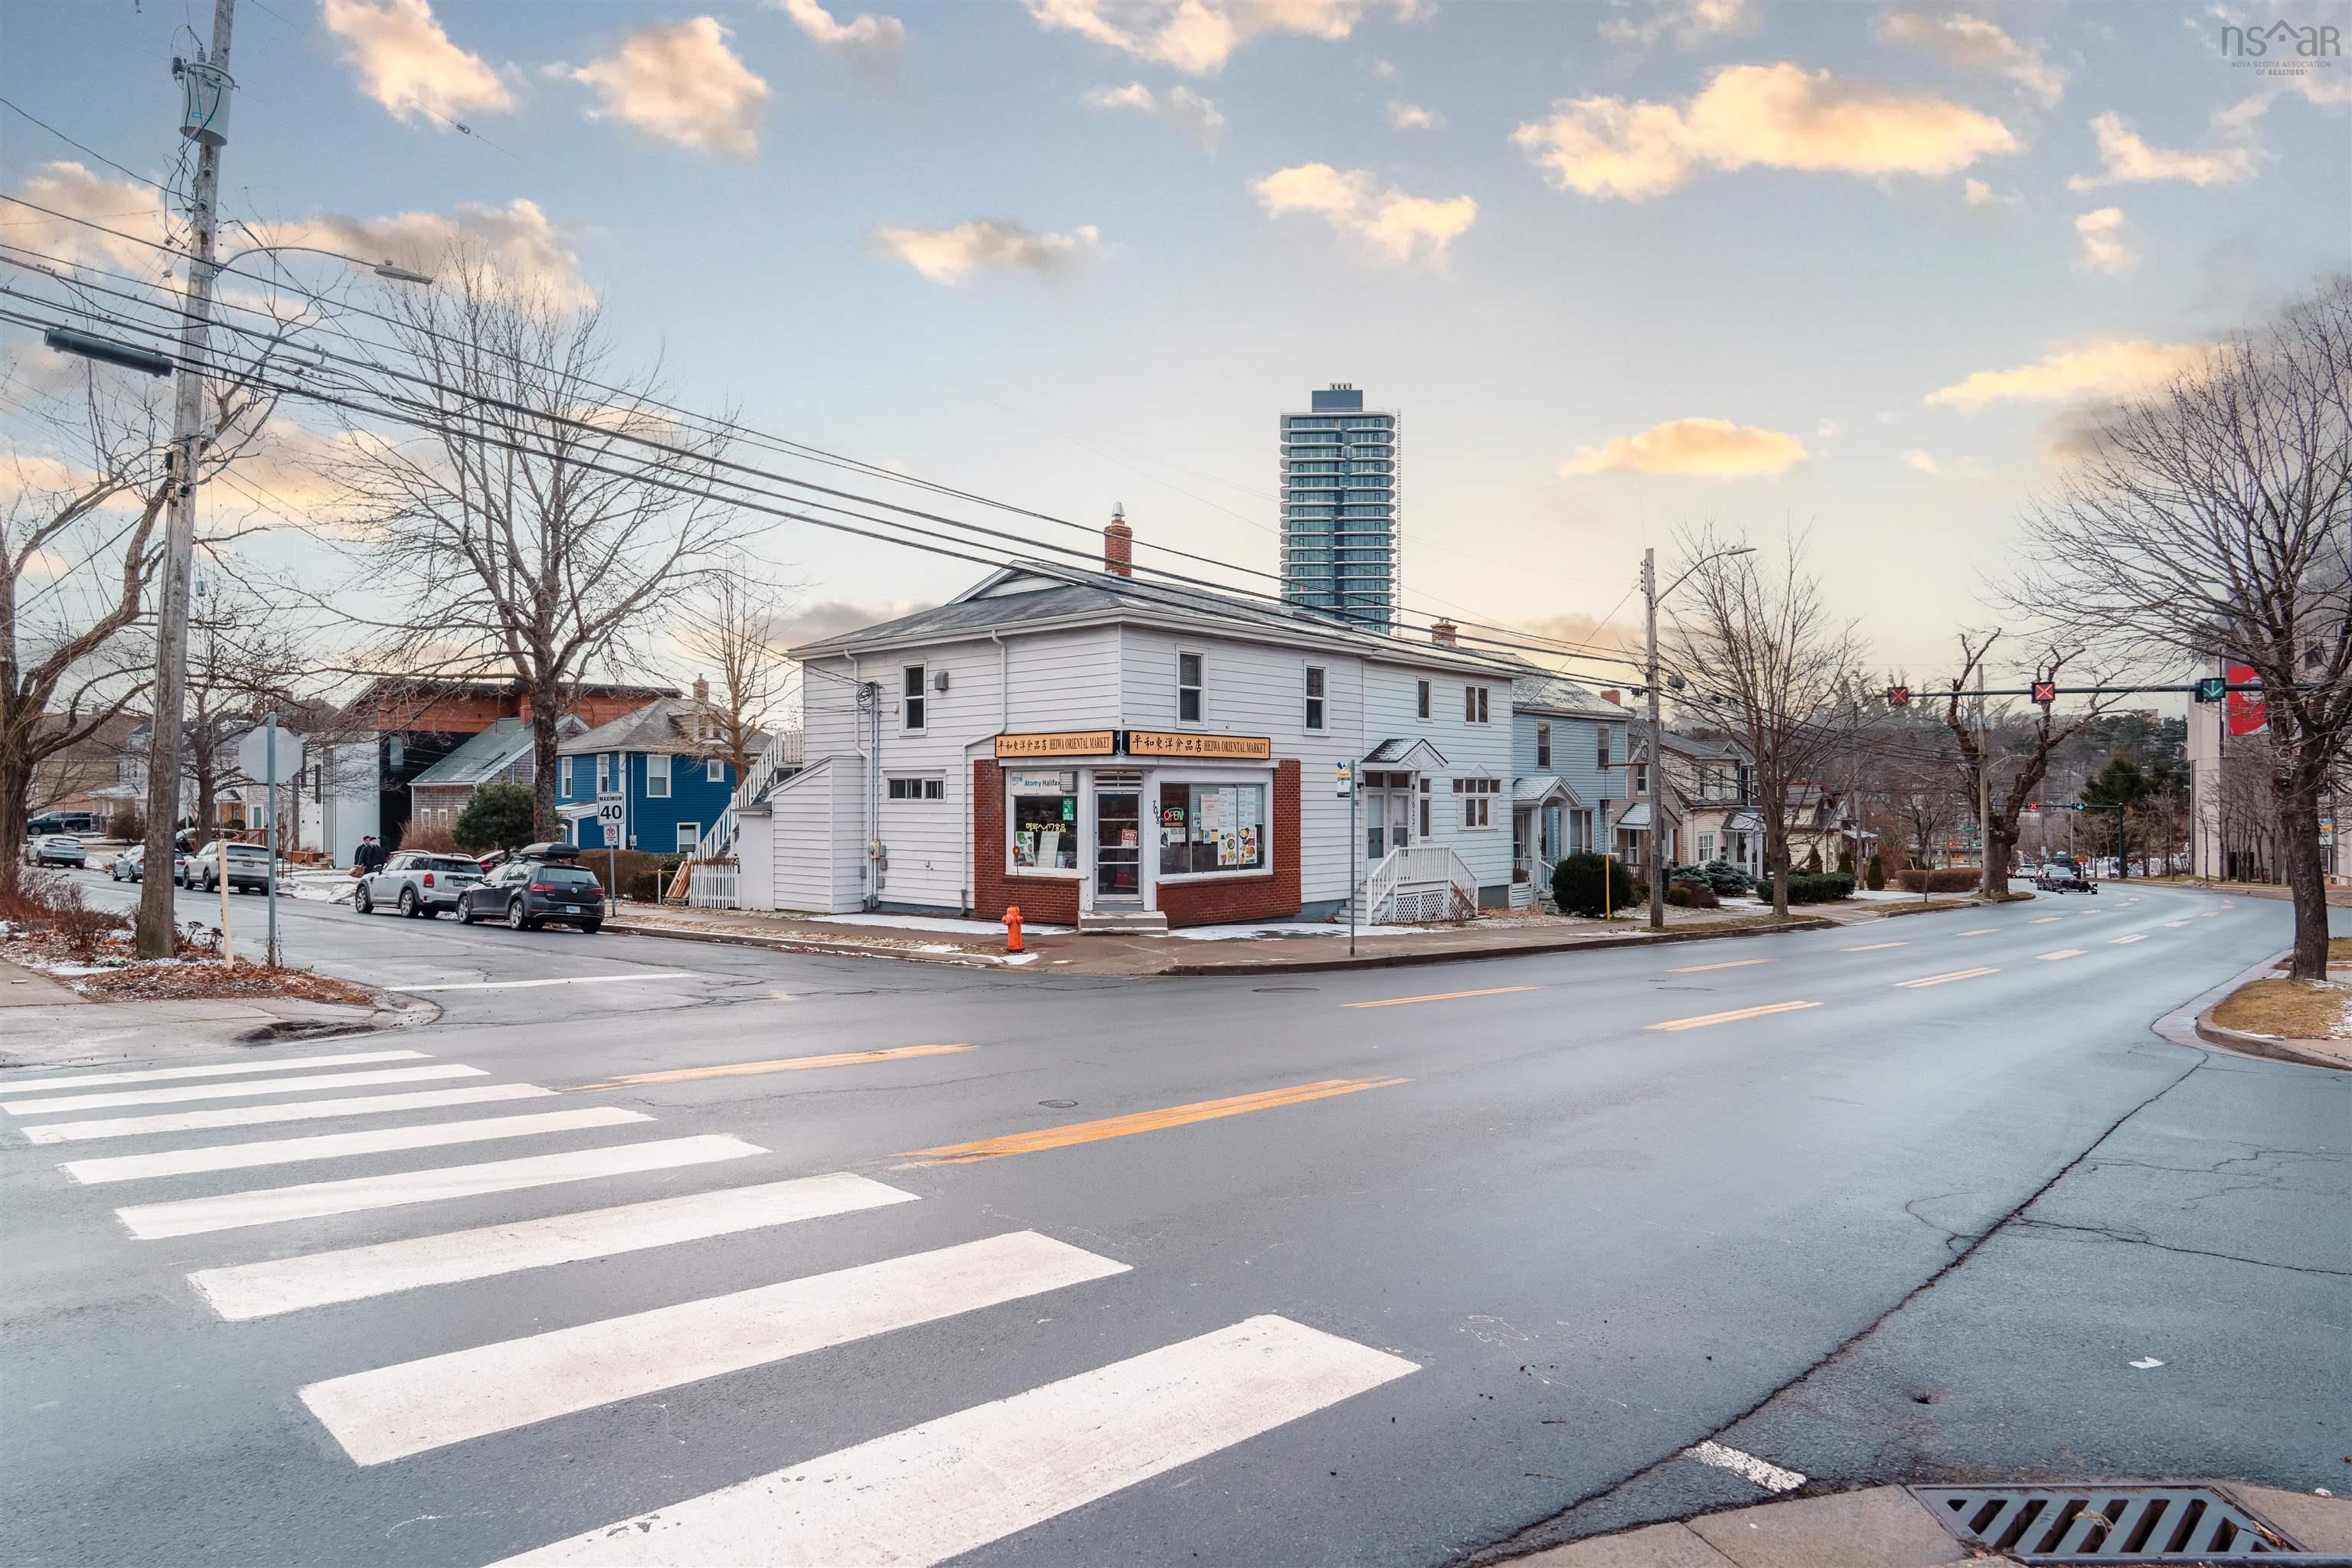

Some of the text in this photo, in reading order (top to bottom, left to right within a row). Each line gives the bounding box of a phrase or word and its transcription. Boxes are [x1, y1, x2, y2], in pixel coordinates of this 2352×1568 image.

[1049, 738, 1065, 750] HEIWA
[1065, 737, 1089, 750] ORIENTAL
[1089, 737, 1110, 749] MARKET
[1204, 740, 1220, 752] HEIWA
[1221, 741, 1246, 753] ORIENTAL
[1246, 742, 1266, 754] MARKET
[1024, 779, 1041, 788] Atomy
[600, 805, 622, 819] 40
[1164, 810, 1184, 821] OPEN
